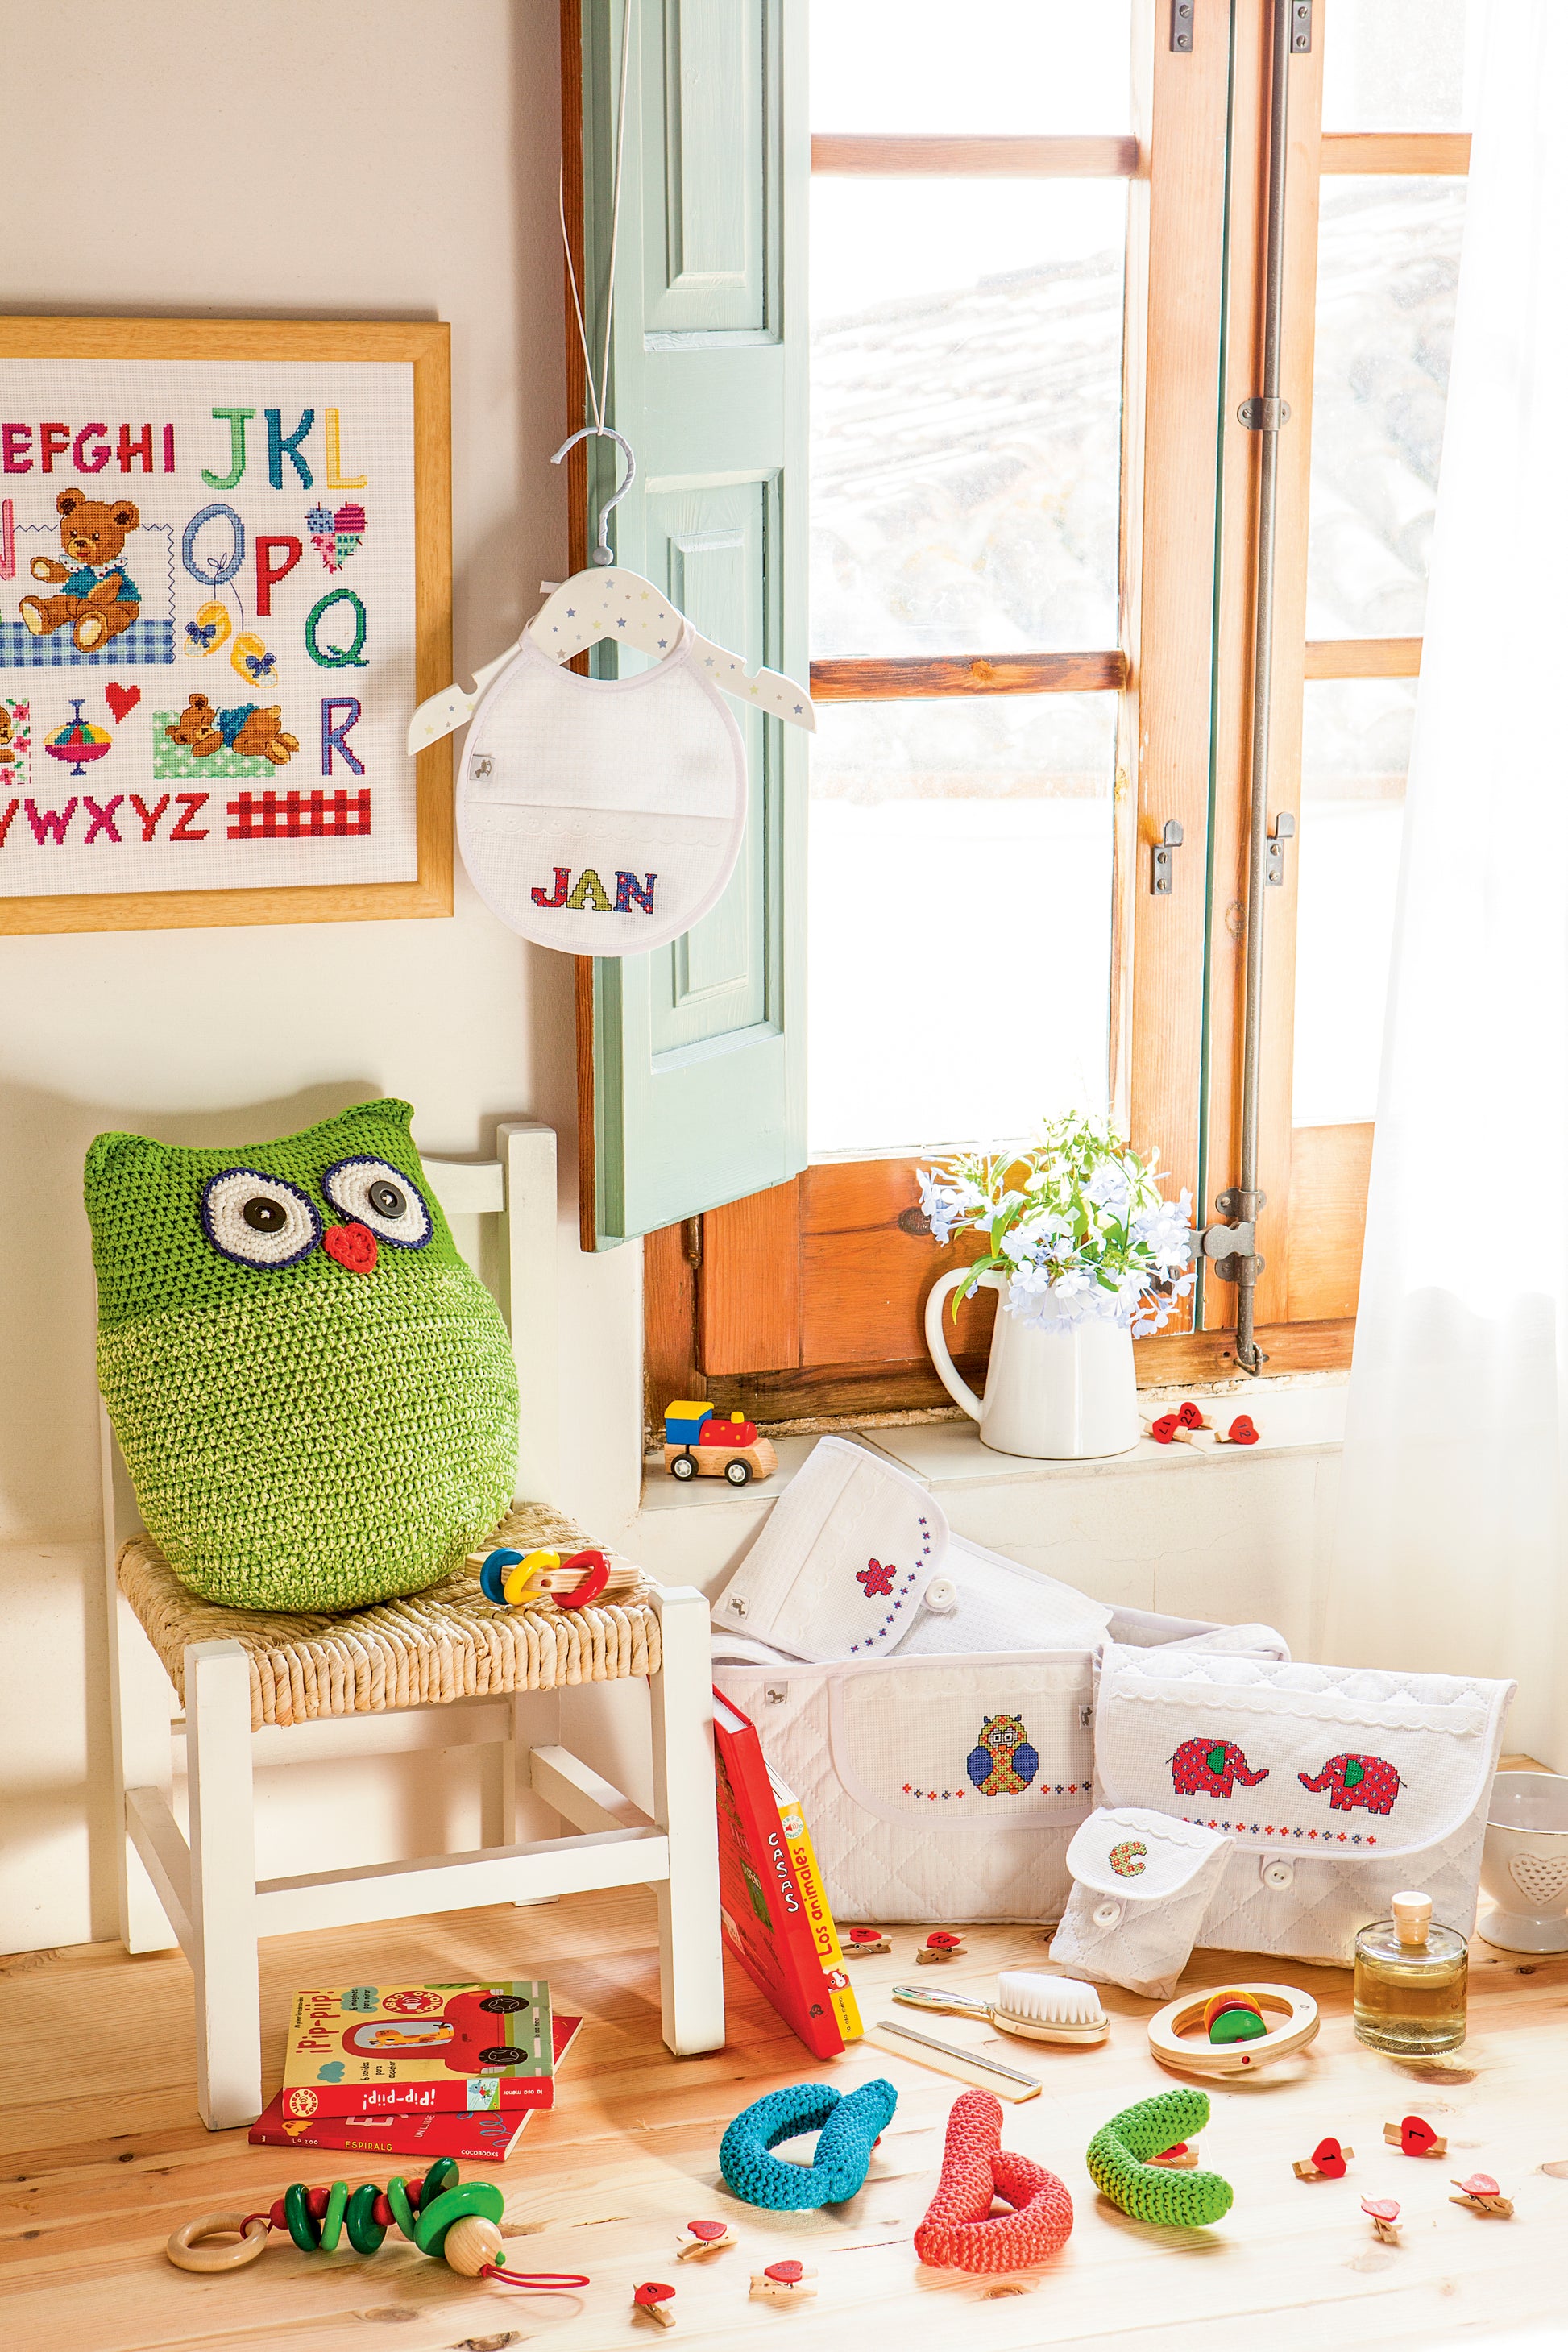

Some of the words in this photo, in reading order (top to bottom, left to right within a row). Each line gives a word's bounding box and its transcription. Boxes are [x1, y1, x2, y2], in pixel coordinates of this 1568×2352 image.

[322, 697, 366, 776] R
[531, 867, 657, 915] JAN
[1180, 1408, 1196, 1425] 22
[1159, 1421, 1171, 1435] 17
[1238, 1423, 1251, 1438] 12
[768, 1832, 800, 1913] CASAS
[794, 1847, 823, 1921] animales
[815, 1925, 833, 1957] Los
[385, 1993, 404, 2012] LIBRO
[413, 1991, 442, 2014] SONORO
[296, 1991, 342, 2053] ¡Pip-piip!
[360, 2062, 369, 2076] sonidos
[375, 2065, 385, 2076] para
[292, 2093, 301, 2113] LIBRO
[303, 2090, 317, 2115] SONORO
[362, 2089, 436, 2110] ¡Pip-piip!
[1409, 2130, 1425, 2139] 7
[345, 2140, 392, 2151] ESPIRALS
[461, 2149, 499, 2157] COCOBOOKS
[1322, 2153, 1336, 2161] 1
